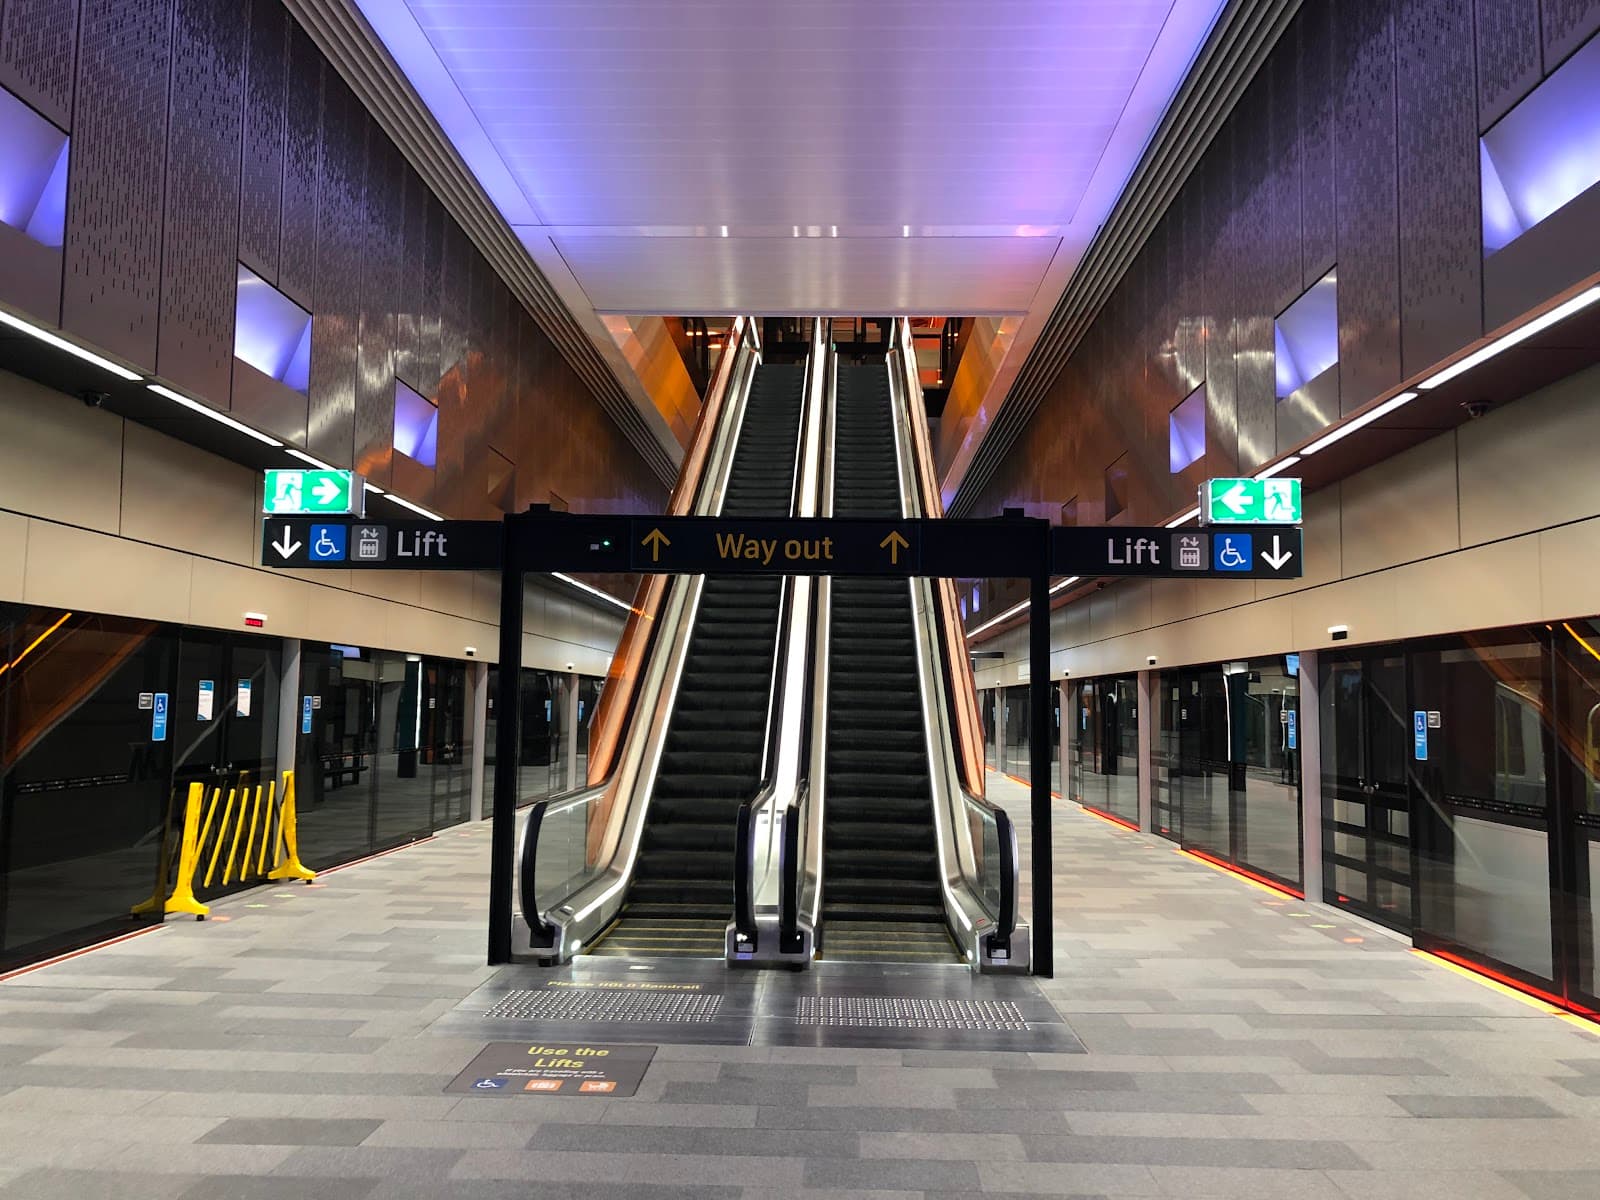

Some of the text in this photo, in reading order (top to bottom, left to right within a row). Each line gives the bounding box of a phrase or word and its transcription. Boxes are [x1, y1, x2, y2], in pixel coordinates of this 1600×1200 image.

[397, 530, 448, 557] Lift
[716, 532, 834, 566] Way out
[1108, 538, 1160, 564] Lift
[527, 1046, 609, 1057] Use the
[534, 1058, 585, 1068] Lifts
